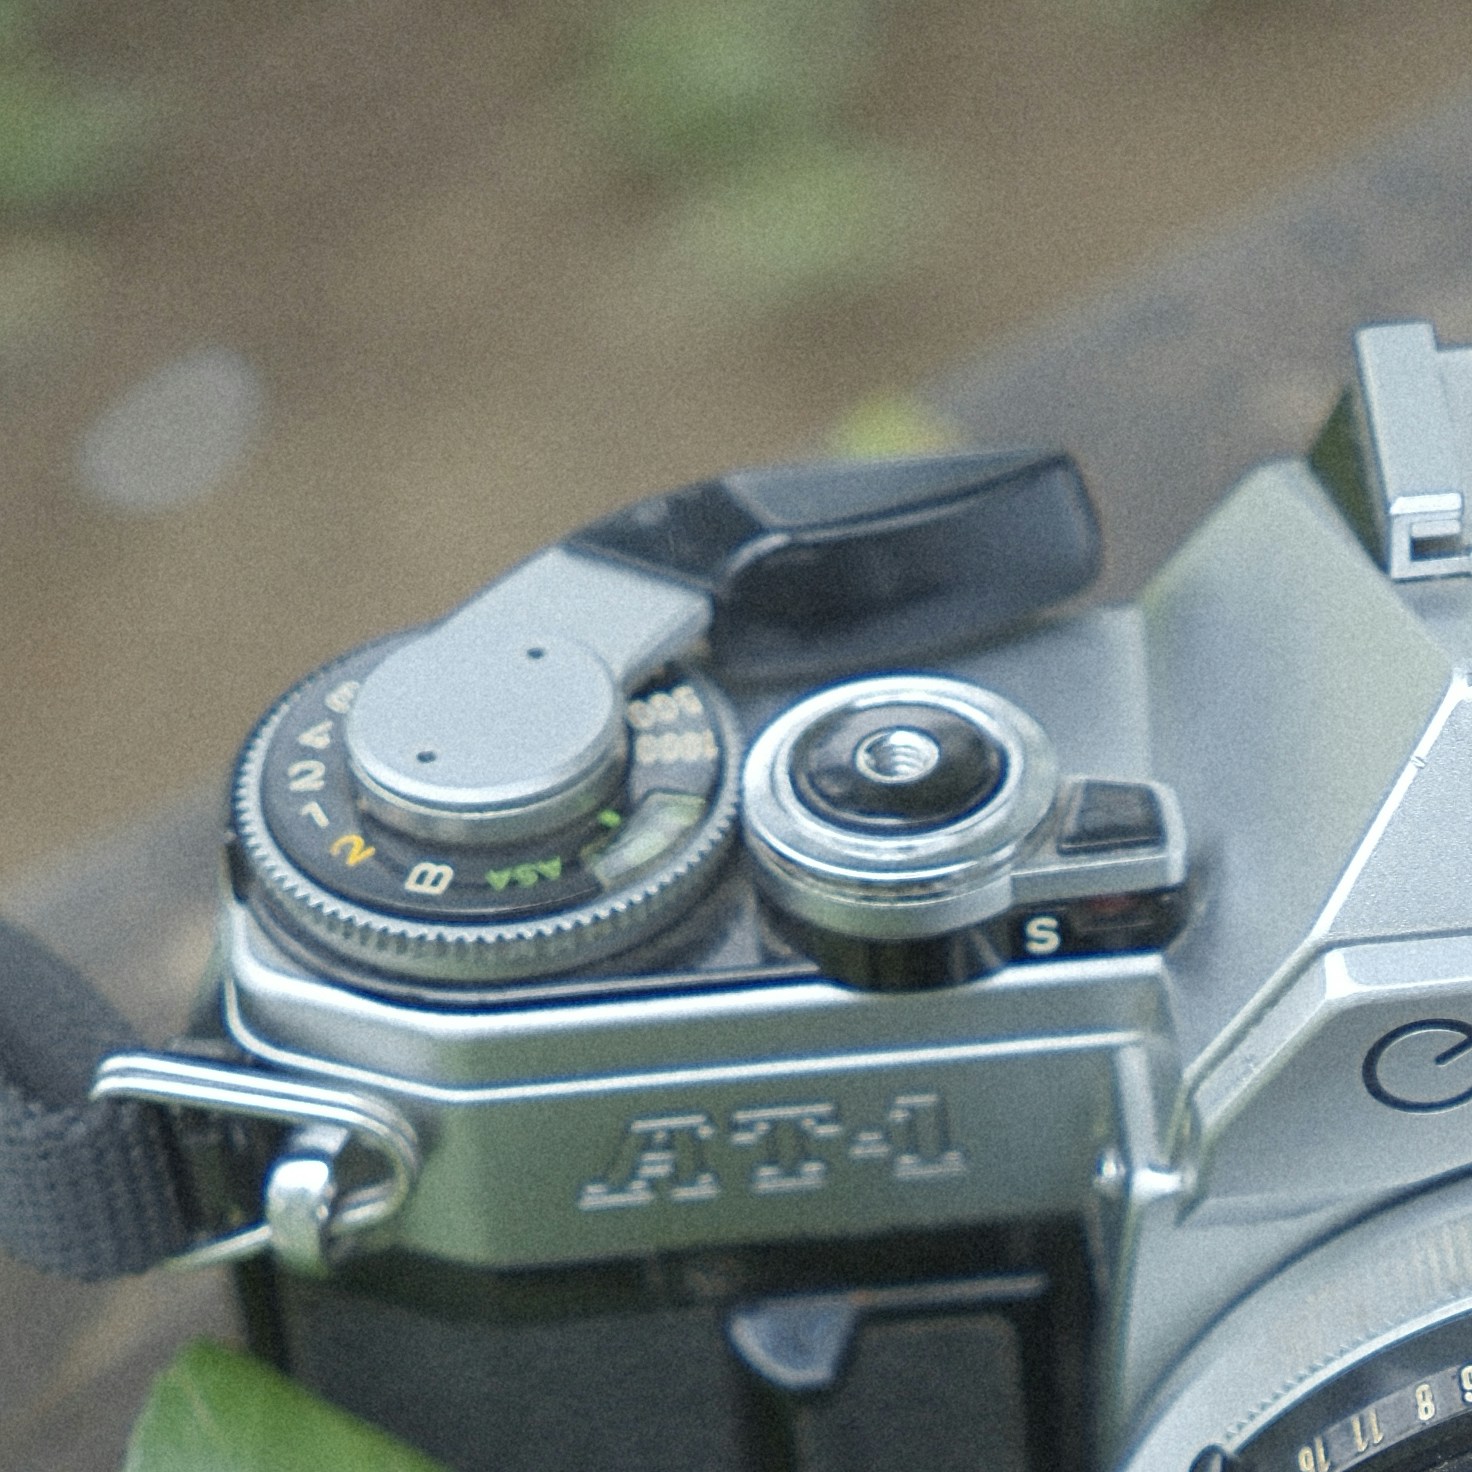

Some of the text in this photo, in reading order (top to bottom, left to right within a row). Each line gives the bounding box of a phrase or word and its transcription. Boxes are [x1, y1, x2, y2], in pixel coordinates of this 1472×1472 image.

[287, 760, 326, 792] 2
[329, 834, 375, 866] 2
[403, 862, 455, 896] B
[486, 857, 562, 892] ASA
[1026, 916, 1061, 955] S
[580, 1094, 964, 1209] AT-1
[1415, 1383, 1435, 1421] 8
[1351, 1407, 1384, 1452] 11
